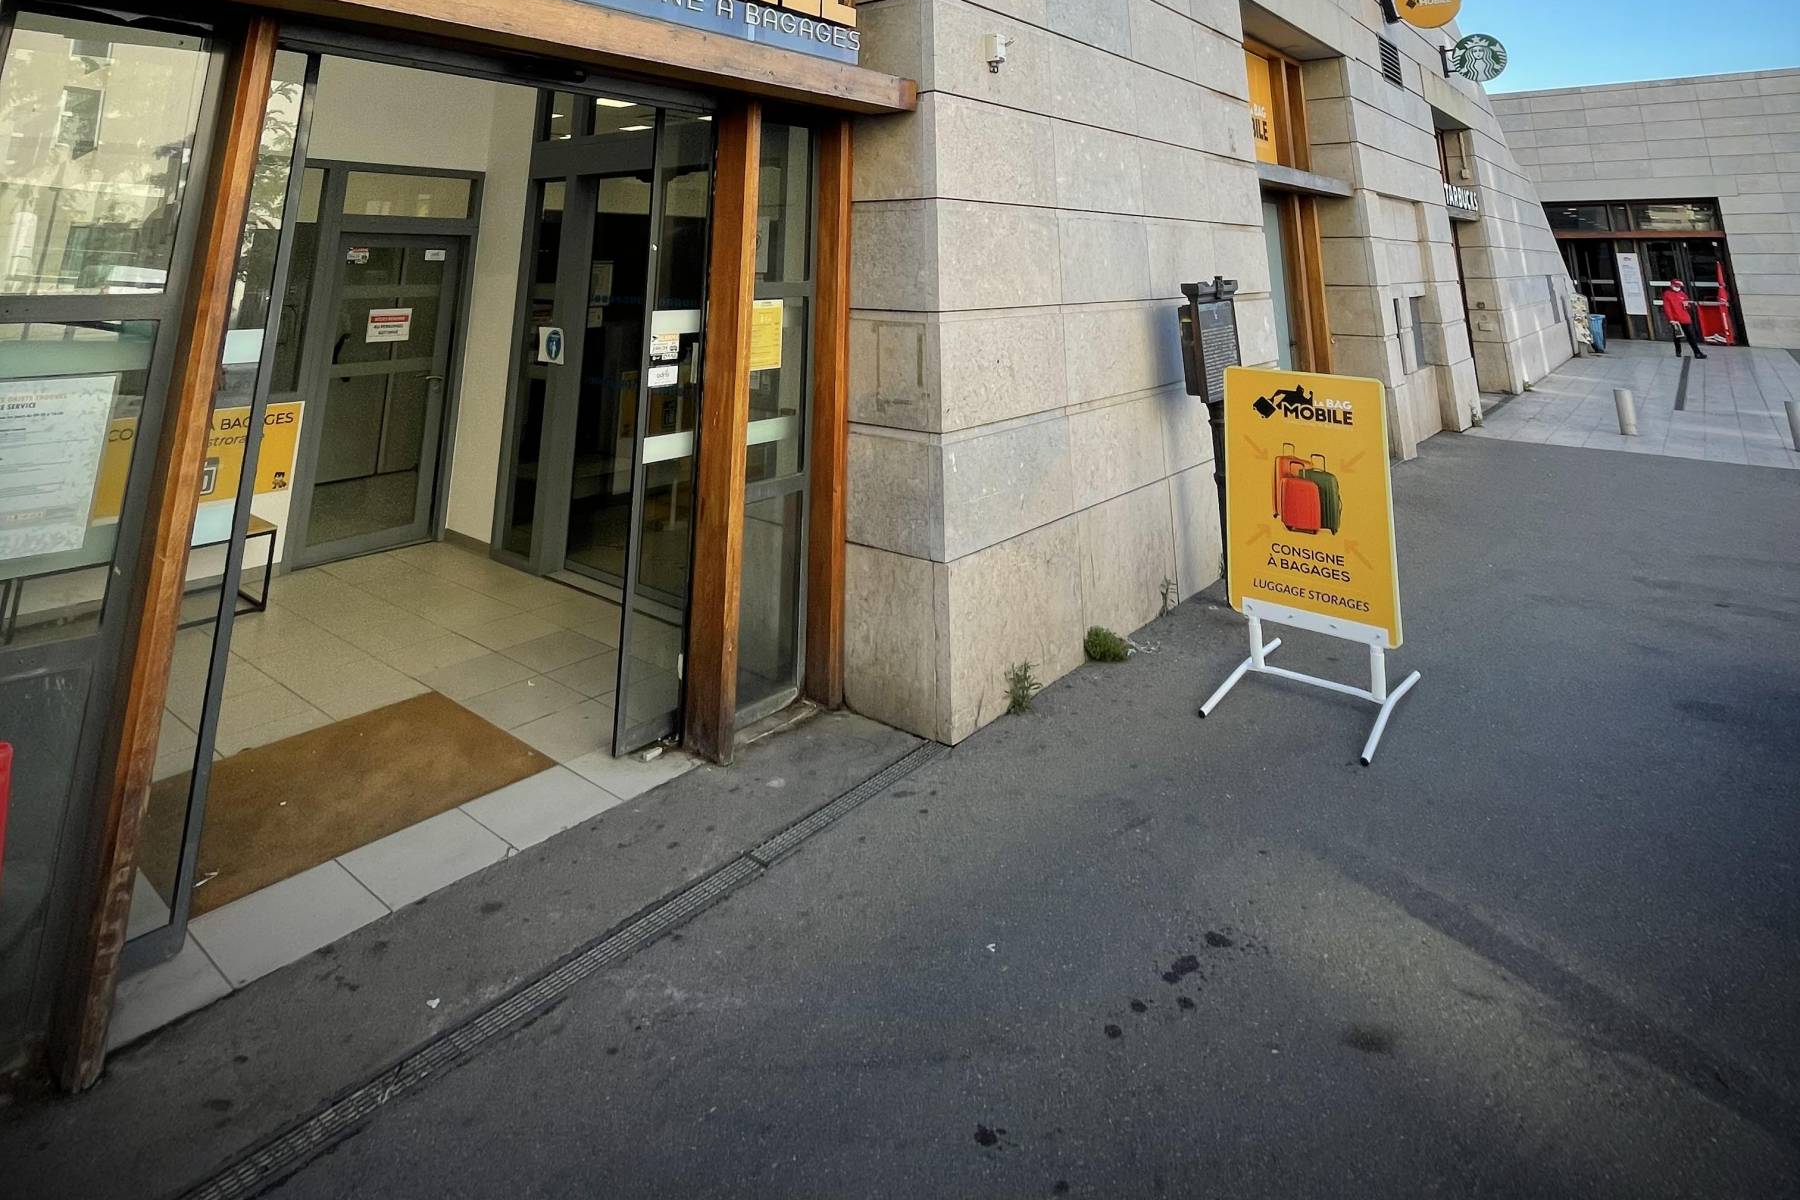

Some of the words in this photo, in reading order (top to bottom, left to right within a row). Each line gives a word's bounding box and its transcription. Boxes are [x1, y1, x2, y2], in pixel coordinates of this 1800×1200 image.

[744, 2, 861, 52] BAGAGES
[1443, 182, 1479, 211] TARBUCKS
[7, 402, 37, 411] SERVICE
[1283, 403, 1353, 426] MOBILE
[1326, 399, 1353, 410] BAG
[1267, 552, 1277, 567] À
[1280, 559, 1351, 583] BAGAGES
[1271, 542, 1345, 567] CONSIGNE
[1253, 576, 1306, 598] LUGGAGE
[1308, 588, 1370, 613] STORAGES
